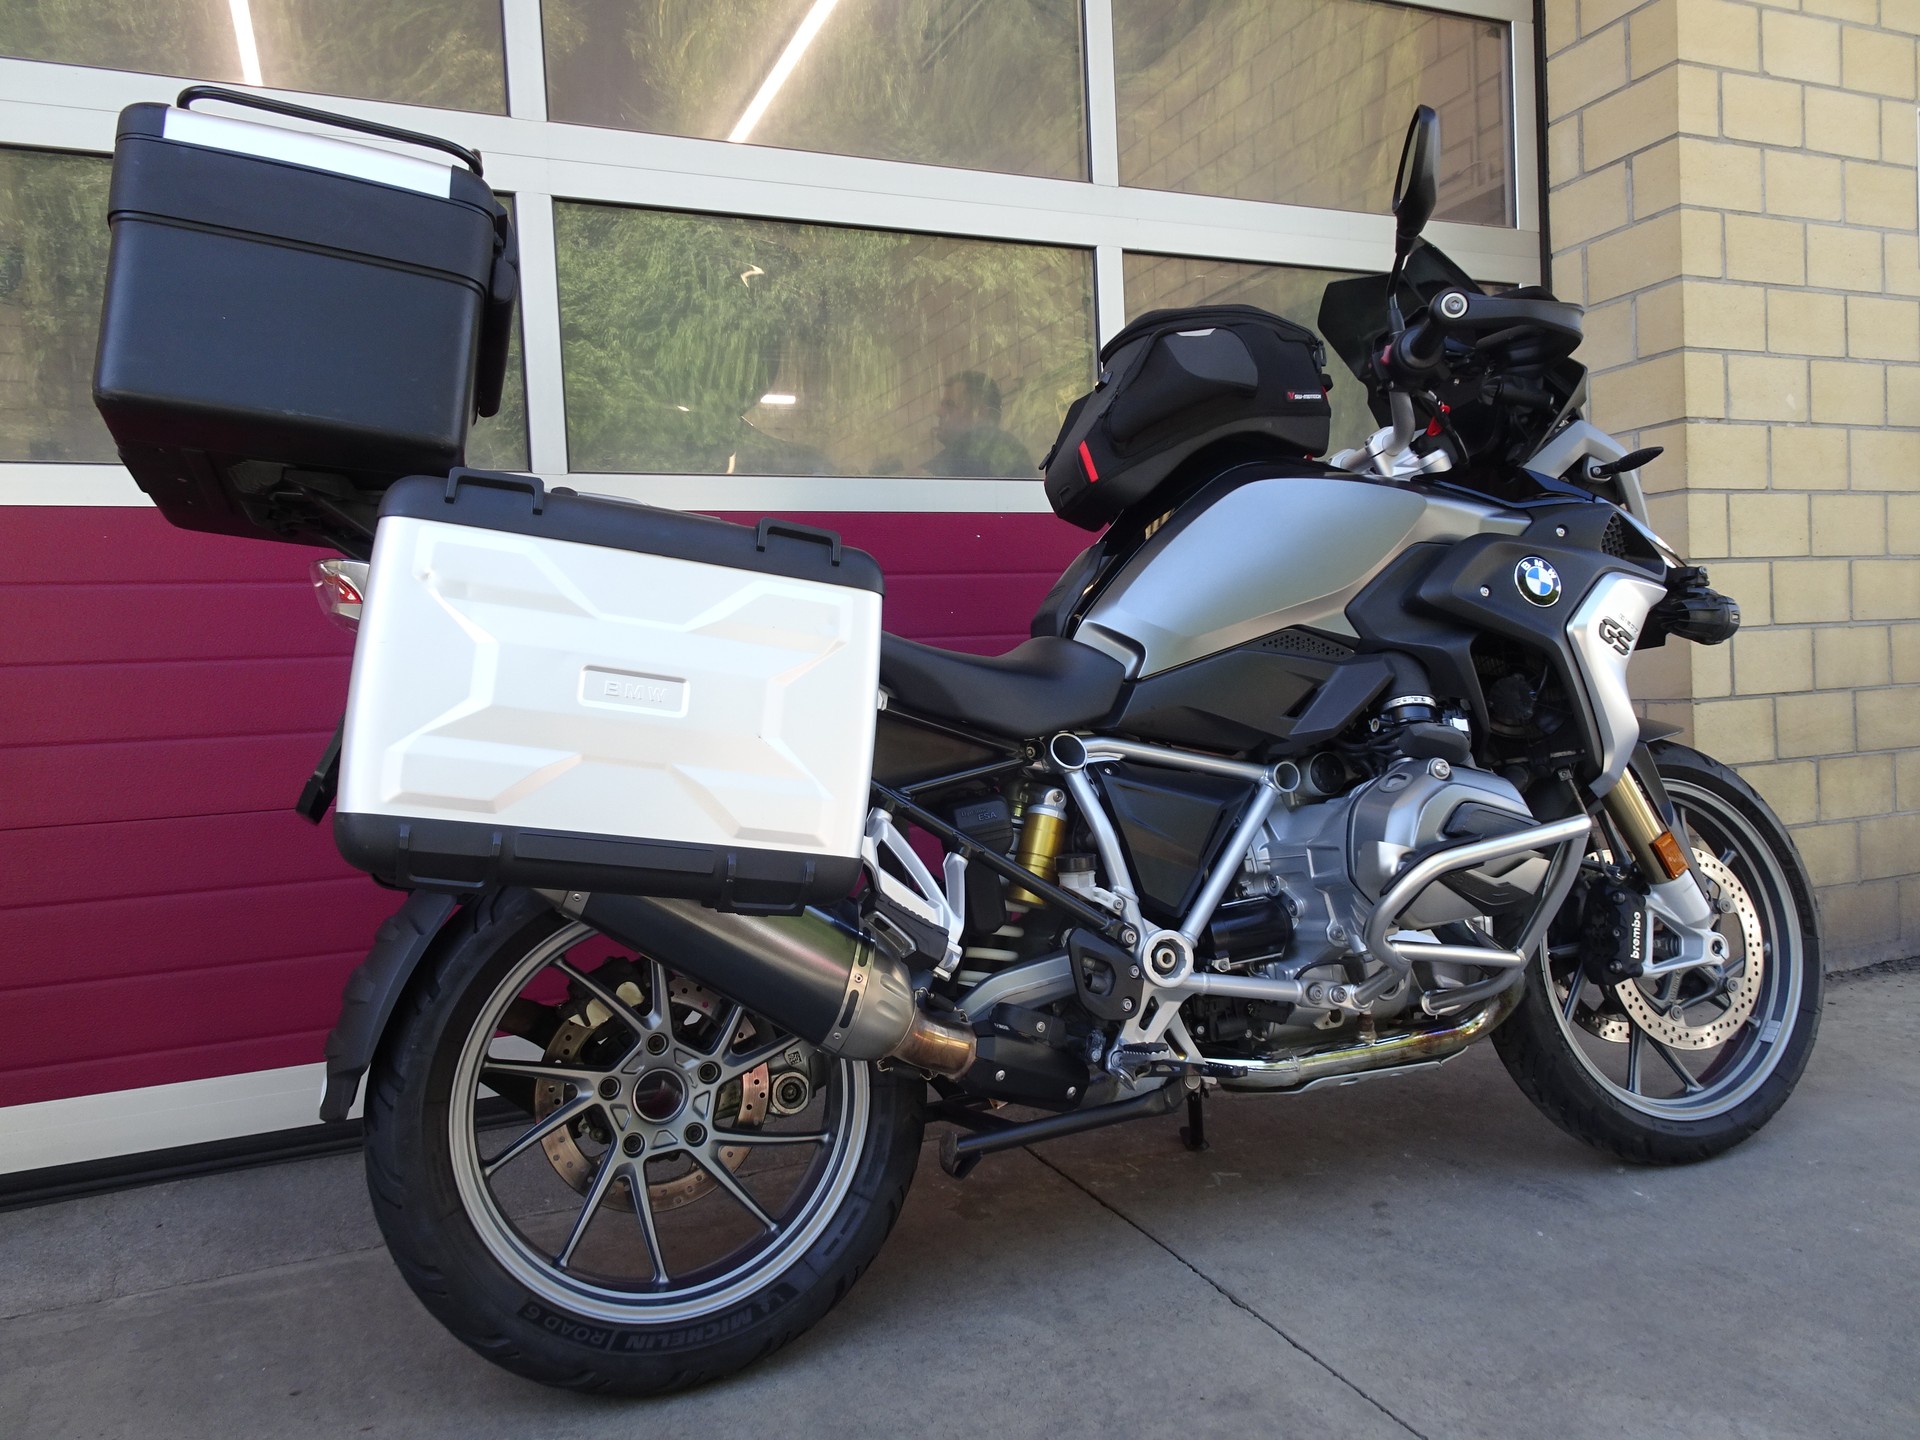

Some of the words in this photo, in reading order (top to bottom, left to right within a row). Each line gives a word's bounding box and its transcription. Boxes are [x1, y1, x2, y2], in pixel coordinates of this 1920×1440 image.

[1520, 559, 1558, 579] BMW
[1599, 616, 1635, 656] GS
[603, 680, 668, 703] BMW
[1630, 911, 1642, 960] brembo
[523, 1304, 541, 1321] 6
[543, 1315, 607, 1345] ROAD
[625, 1308, 753, 1350] MICHELIN
